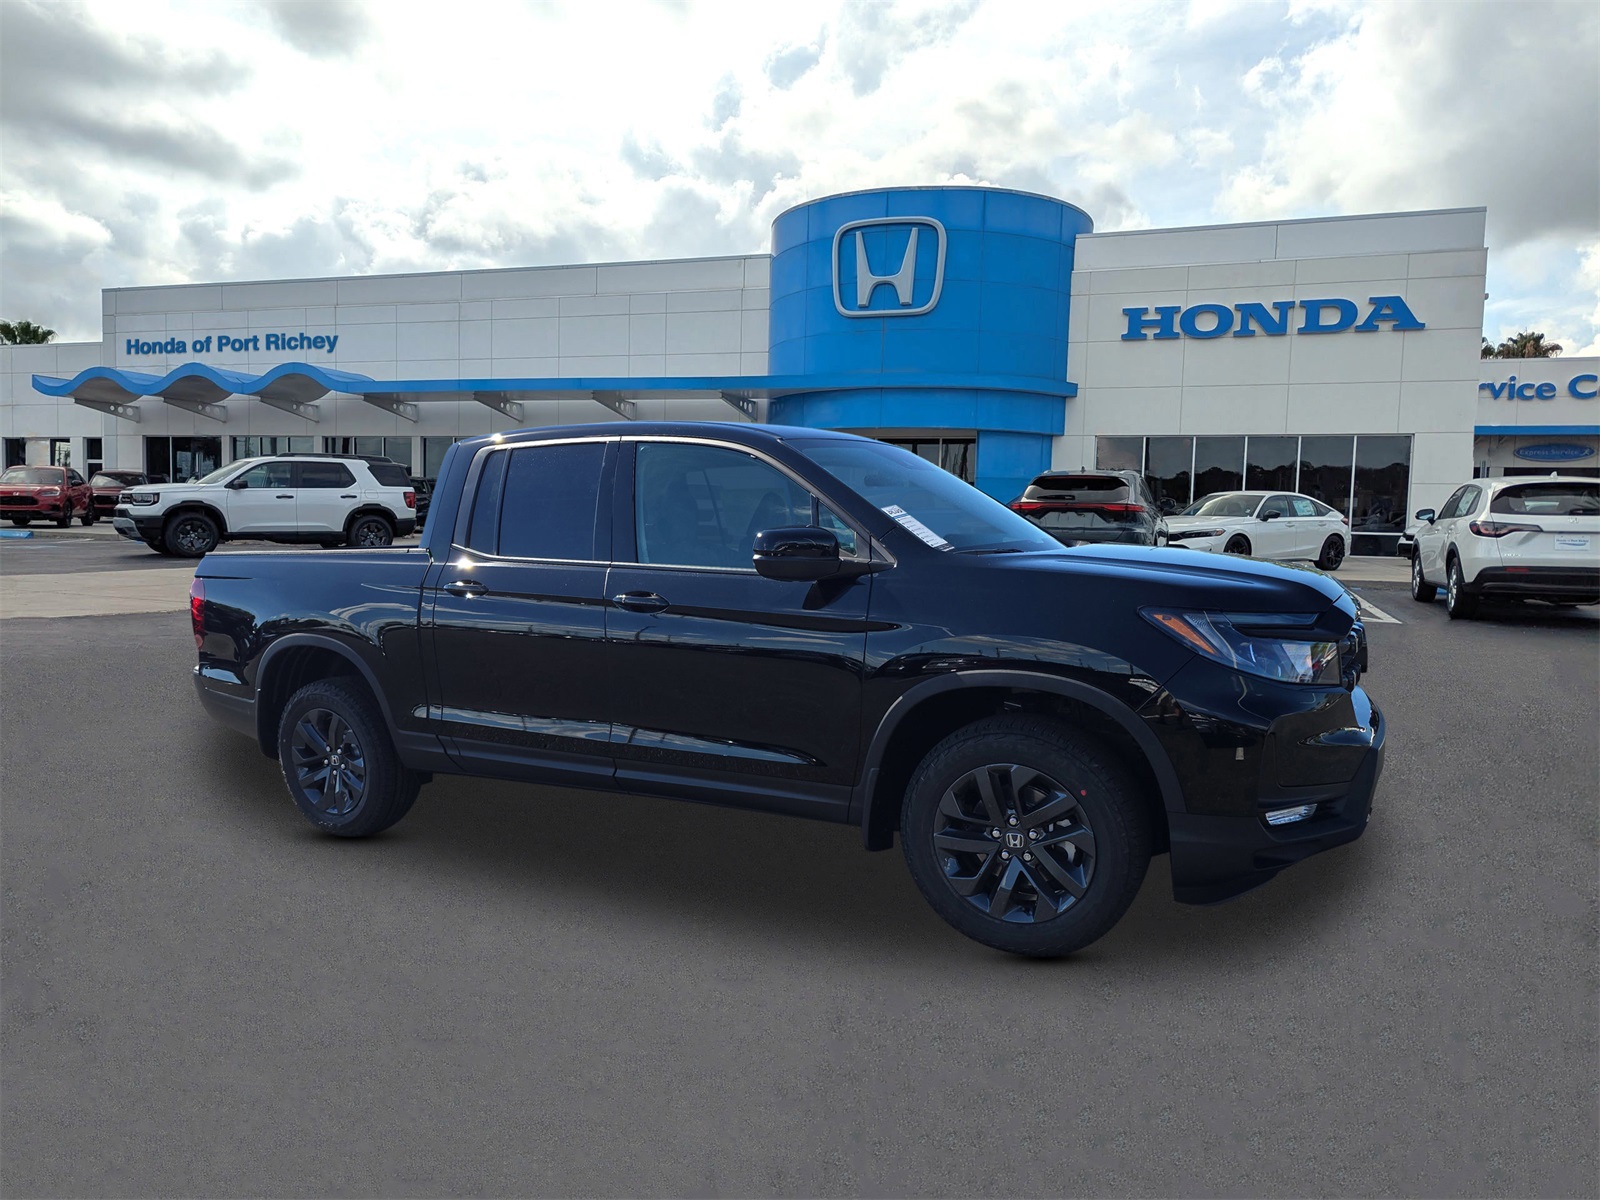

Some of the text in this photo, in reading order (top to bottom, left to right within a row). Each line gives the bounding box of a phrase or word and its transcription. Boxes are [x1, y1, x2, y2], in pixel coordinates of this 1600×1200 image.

[1120, 295, 1427, 341] HONDA
[126, 332, 339, 355] Honda of Port Richey
[1567, 374, 1600, 400] C
